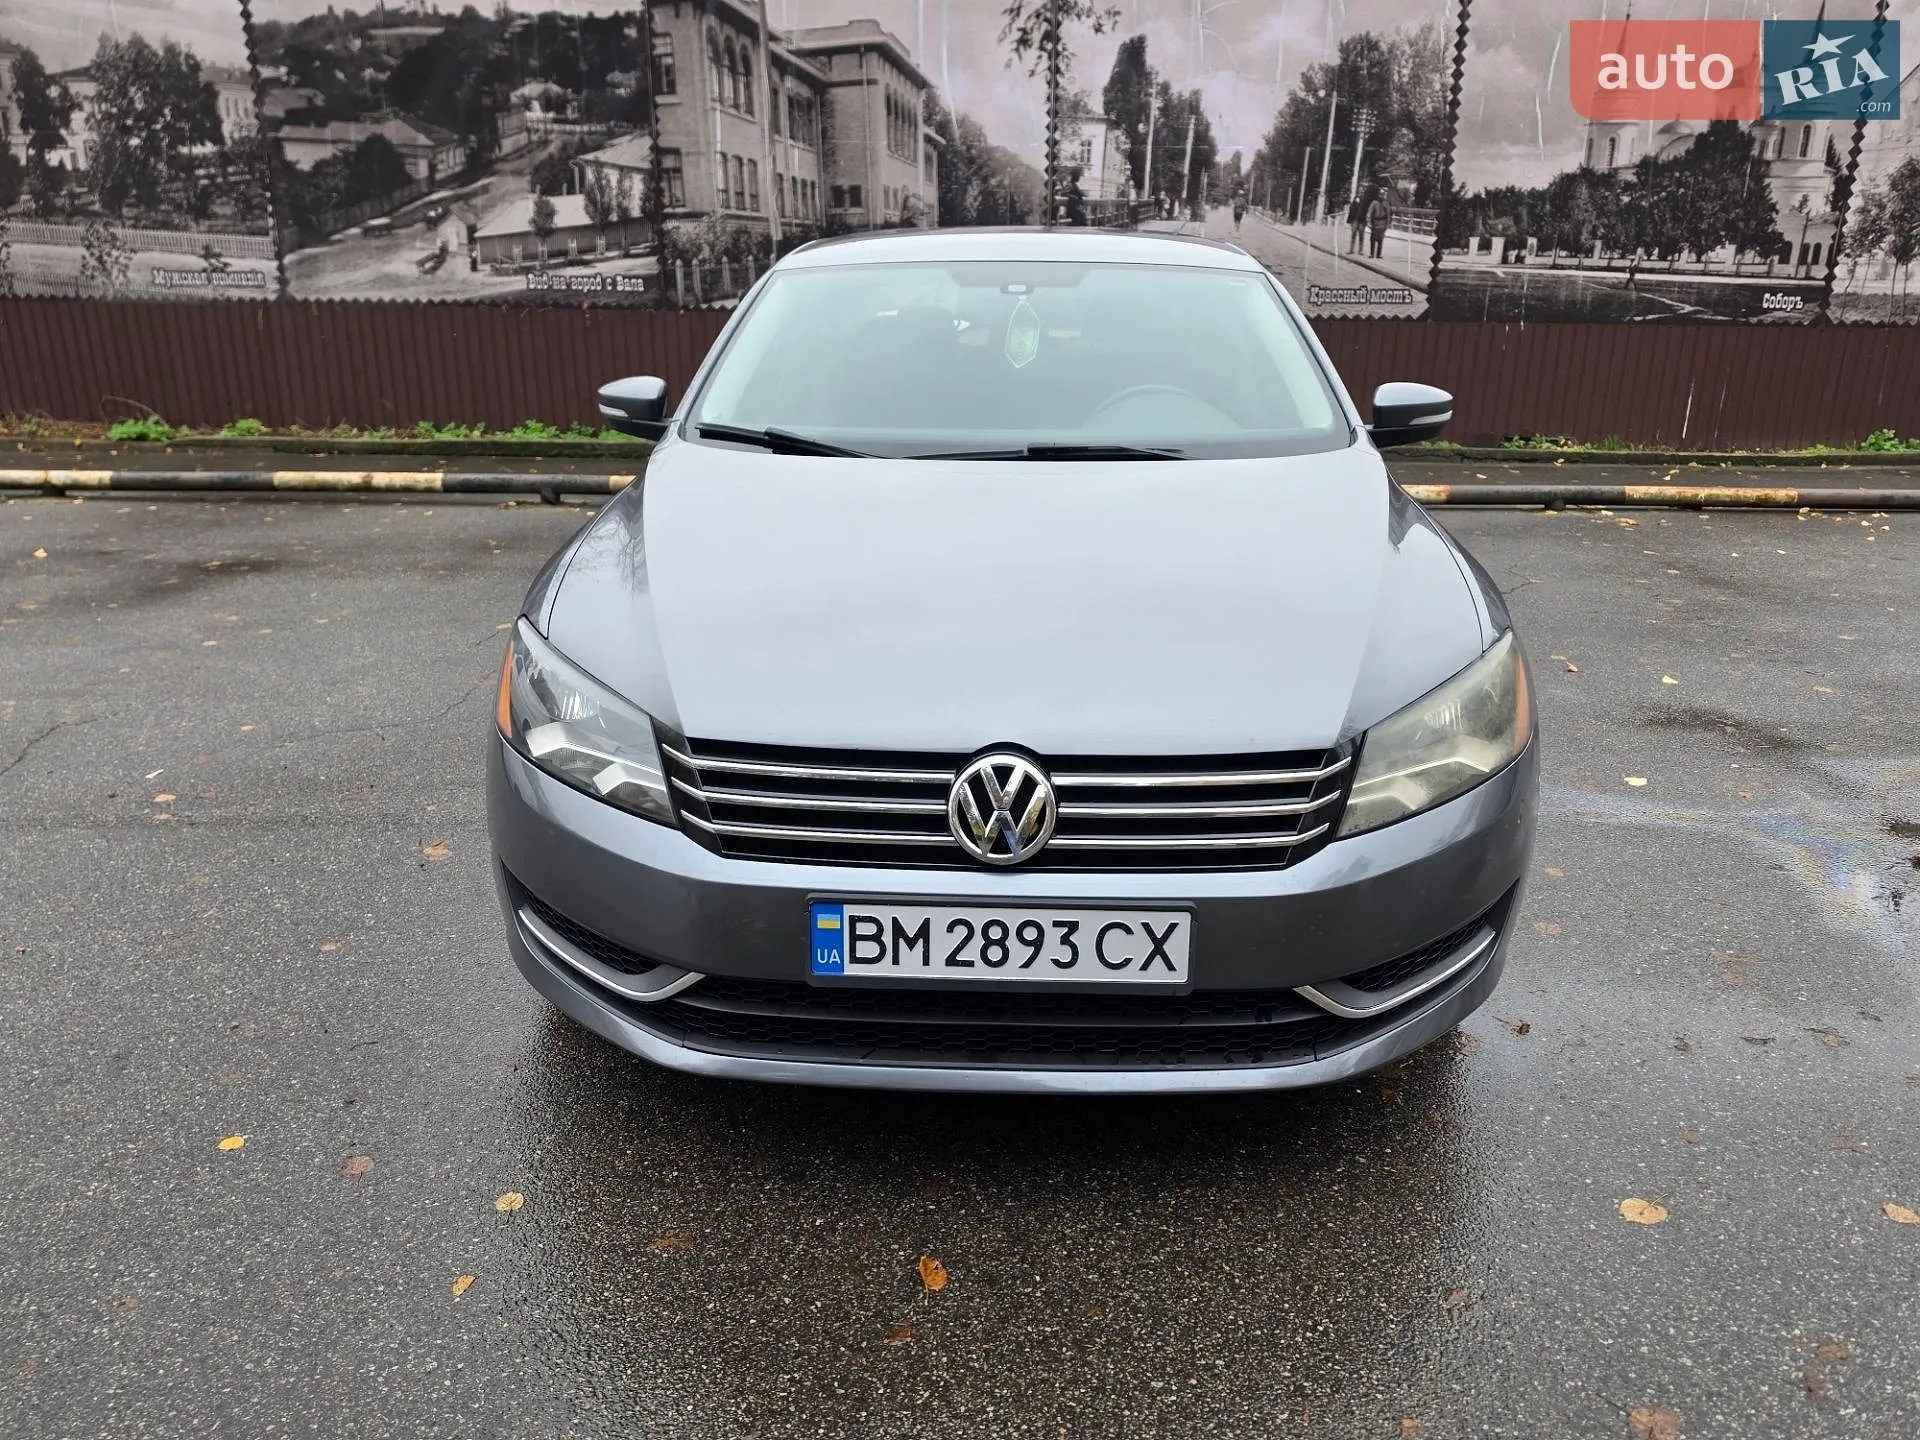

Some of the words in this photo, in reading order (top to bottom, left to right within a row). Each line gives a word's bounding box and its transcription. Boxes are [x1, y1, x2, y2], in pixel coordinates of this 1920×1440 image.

[551, 275, 568, 290] на
[605, 277, 614, 291] с
[1370, 288, 1413, 305] мостъ
[1762, 291, 1804, 312] Соборъ
[847, 913, 931, 967] BM
[944, 917, 1081, 970] 2893
[1095, 921, 1180, 972] CX
[817, 948, 841, 964] UA
